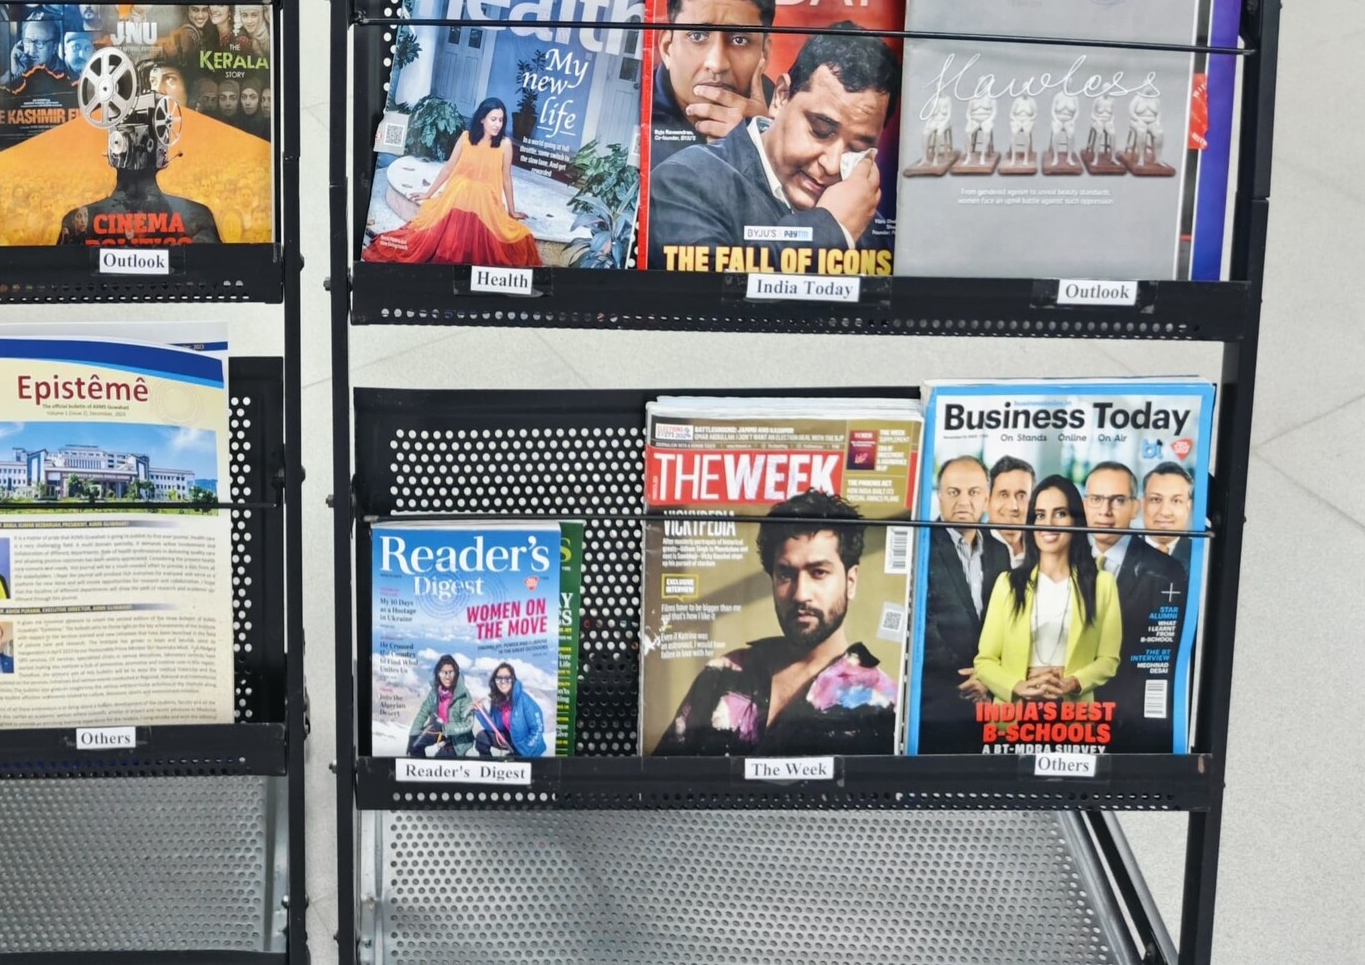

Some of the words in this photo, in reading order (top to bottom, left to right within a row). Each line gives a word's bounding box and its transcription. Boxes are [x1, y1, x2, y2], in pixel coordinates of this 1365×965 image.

[537, 96, 577, 139] life
[93, 212, 185, 235] CINEMA
[103, 253, 165, 270] Outlook
[663, 245, 712, 273] THE
[715, 246, 775, 274] FALL
[780, 247, 812, 275] OF
[817, 247, 893, 275] ICONS
[476, 271, 529, 290] Health
[756, 279, 797, 295] India
[803, 280, 853, 297] Today
[1065, 283, 1130, 301] Outlook
[17, 373, 149, 405] Epistêmê
[943, 402, 1086, 430] Business
[1093, 402, 1191, 435] Today
[379, 535, 550, 575] Reader's
[413, 576, 484, 600] Digest
[467, 600, 525, 623] WOMEN
[508, 616, 547, 638] MOVE
[975, 702, 1061, 723] INDIA'S
[1061, 701, 1116, 721] BEST
[80, 731, 131, 746] Others
[982, 723, 1111, 743] B-SCHOOLS
[405, 764, 470, 778] Reader's
[480, 766, 525, 781] Digest
[751, 762, 781, 776] The
[783, 762, 827, 776] Week
[1037, 756, 1090, 773] Others
